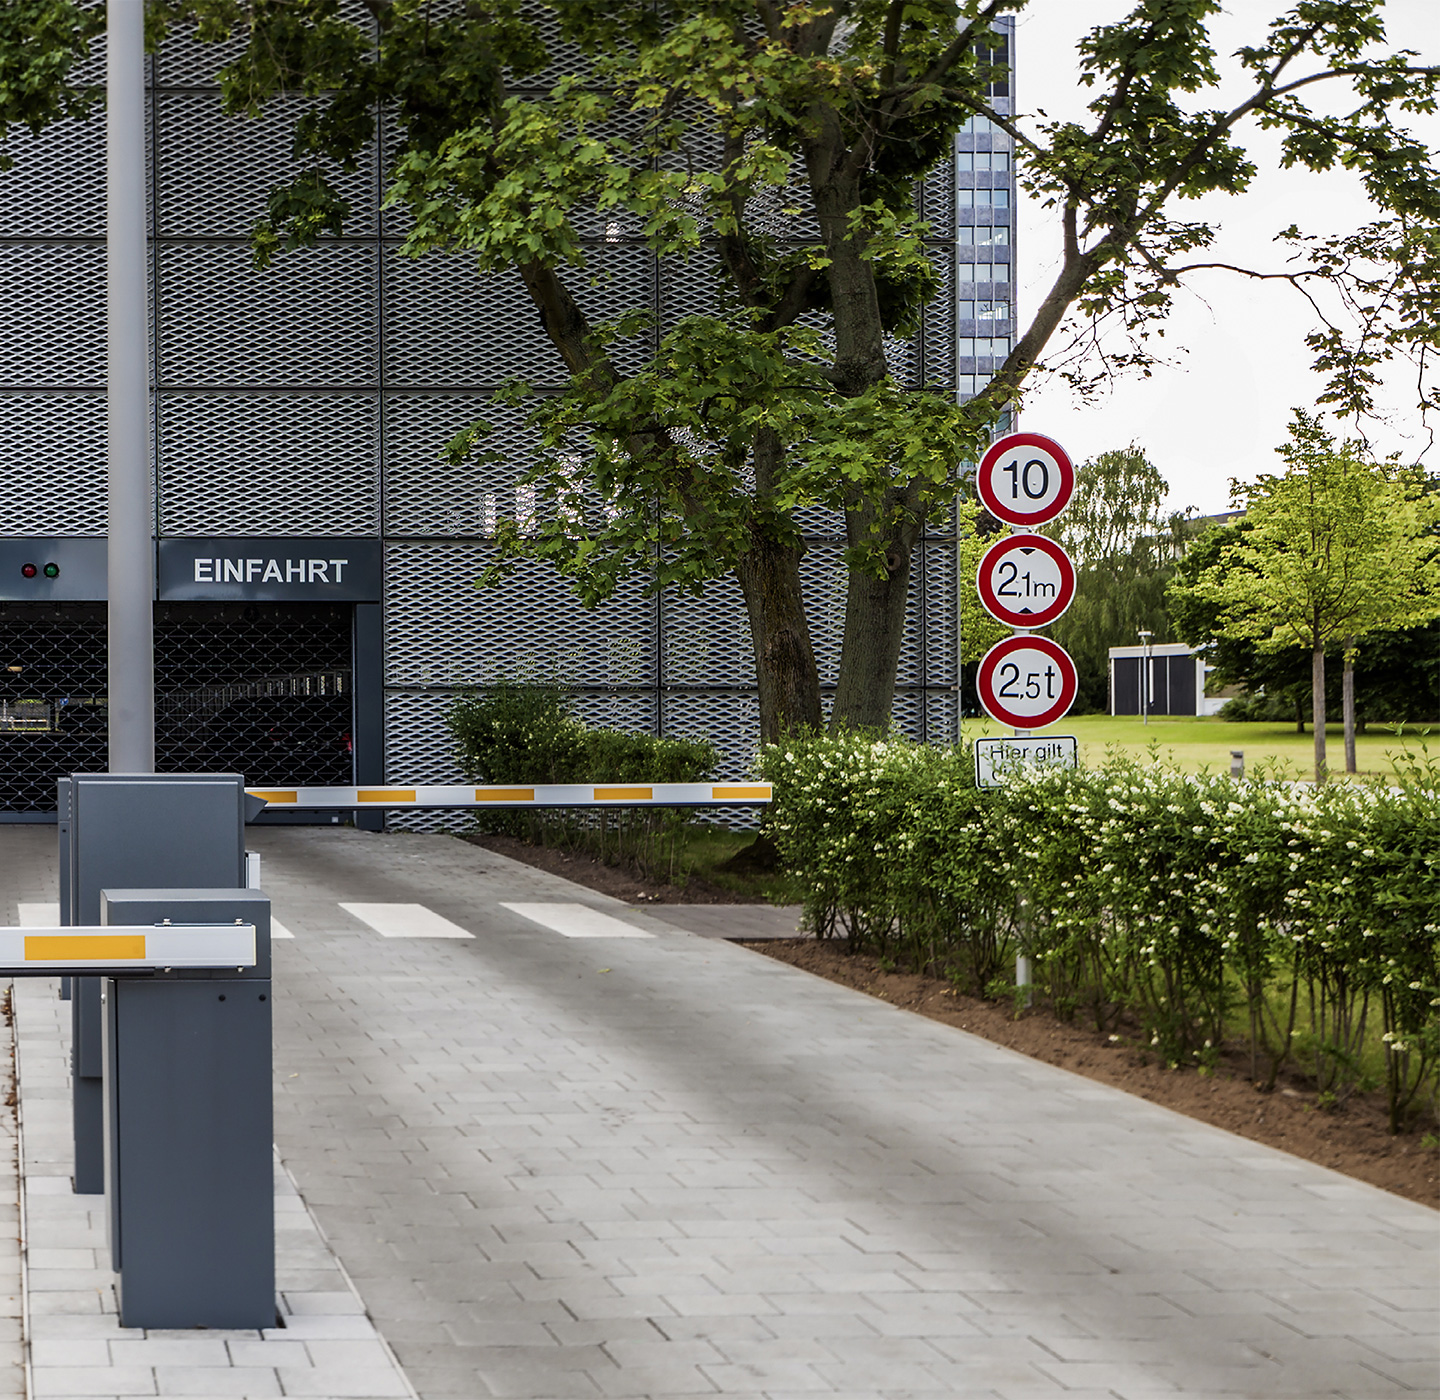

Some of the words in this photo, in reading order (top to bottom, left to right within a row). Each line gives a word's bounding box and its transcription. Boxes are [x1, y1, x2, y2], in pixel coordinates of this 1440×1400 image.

[1002, 459, 1049, 500] 10
[194, 558, 349, 583] EINFAHRT
[990, 744, 1029, 760] Hier
[1035, 743, 1064, 763] gilt
